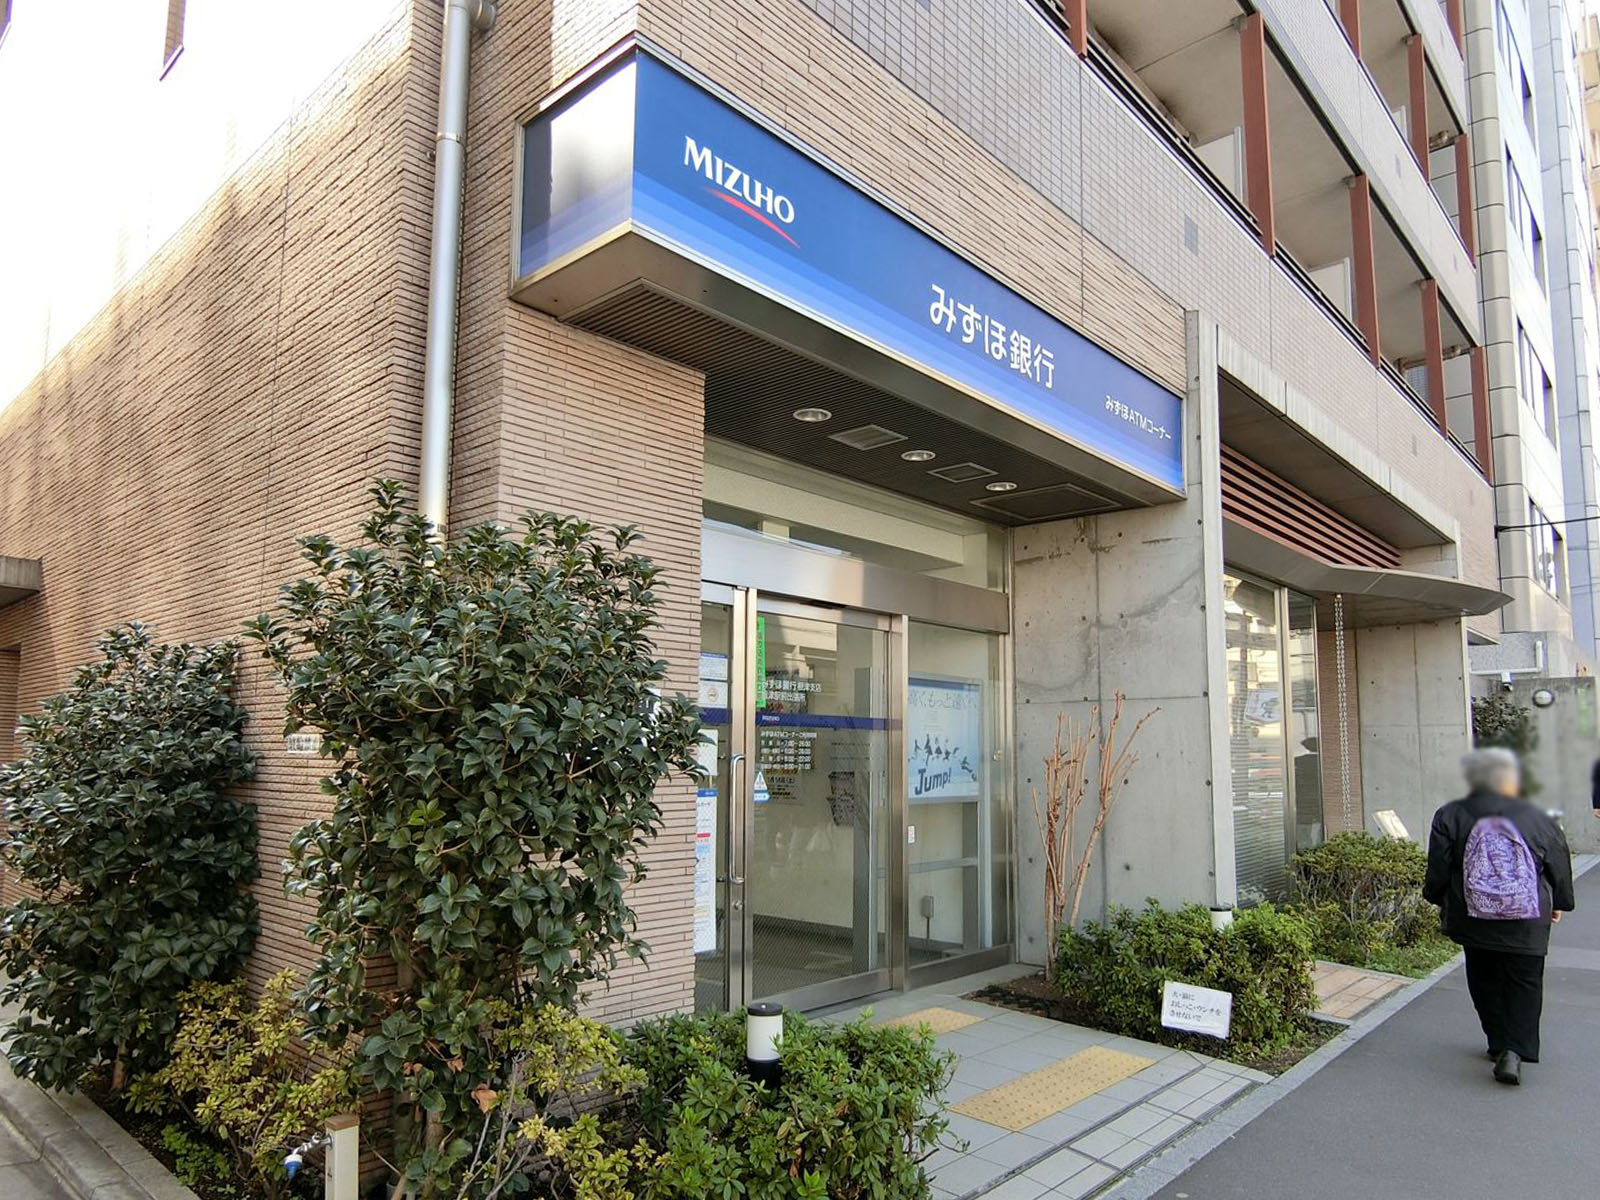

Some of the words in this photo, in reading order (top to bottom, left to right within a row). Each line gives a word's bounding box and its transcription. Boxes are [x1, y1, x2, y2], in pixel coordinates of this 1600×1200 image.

[684, 135, 795, 224] MIZUHO
[930, 284, 1055, 389] みずほ銀行
[1105, 395, 1172, 439] みずほATMコーナー
[914, 767, 952, 796] Jump!
